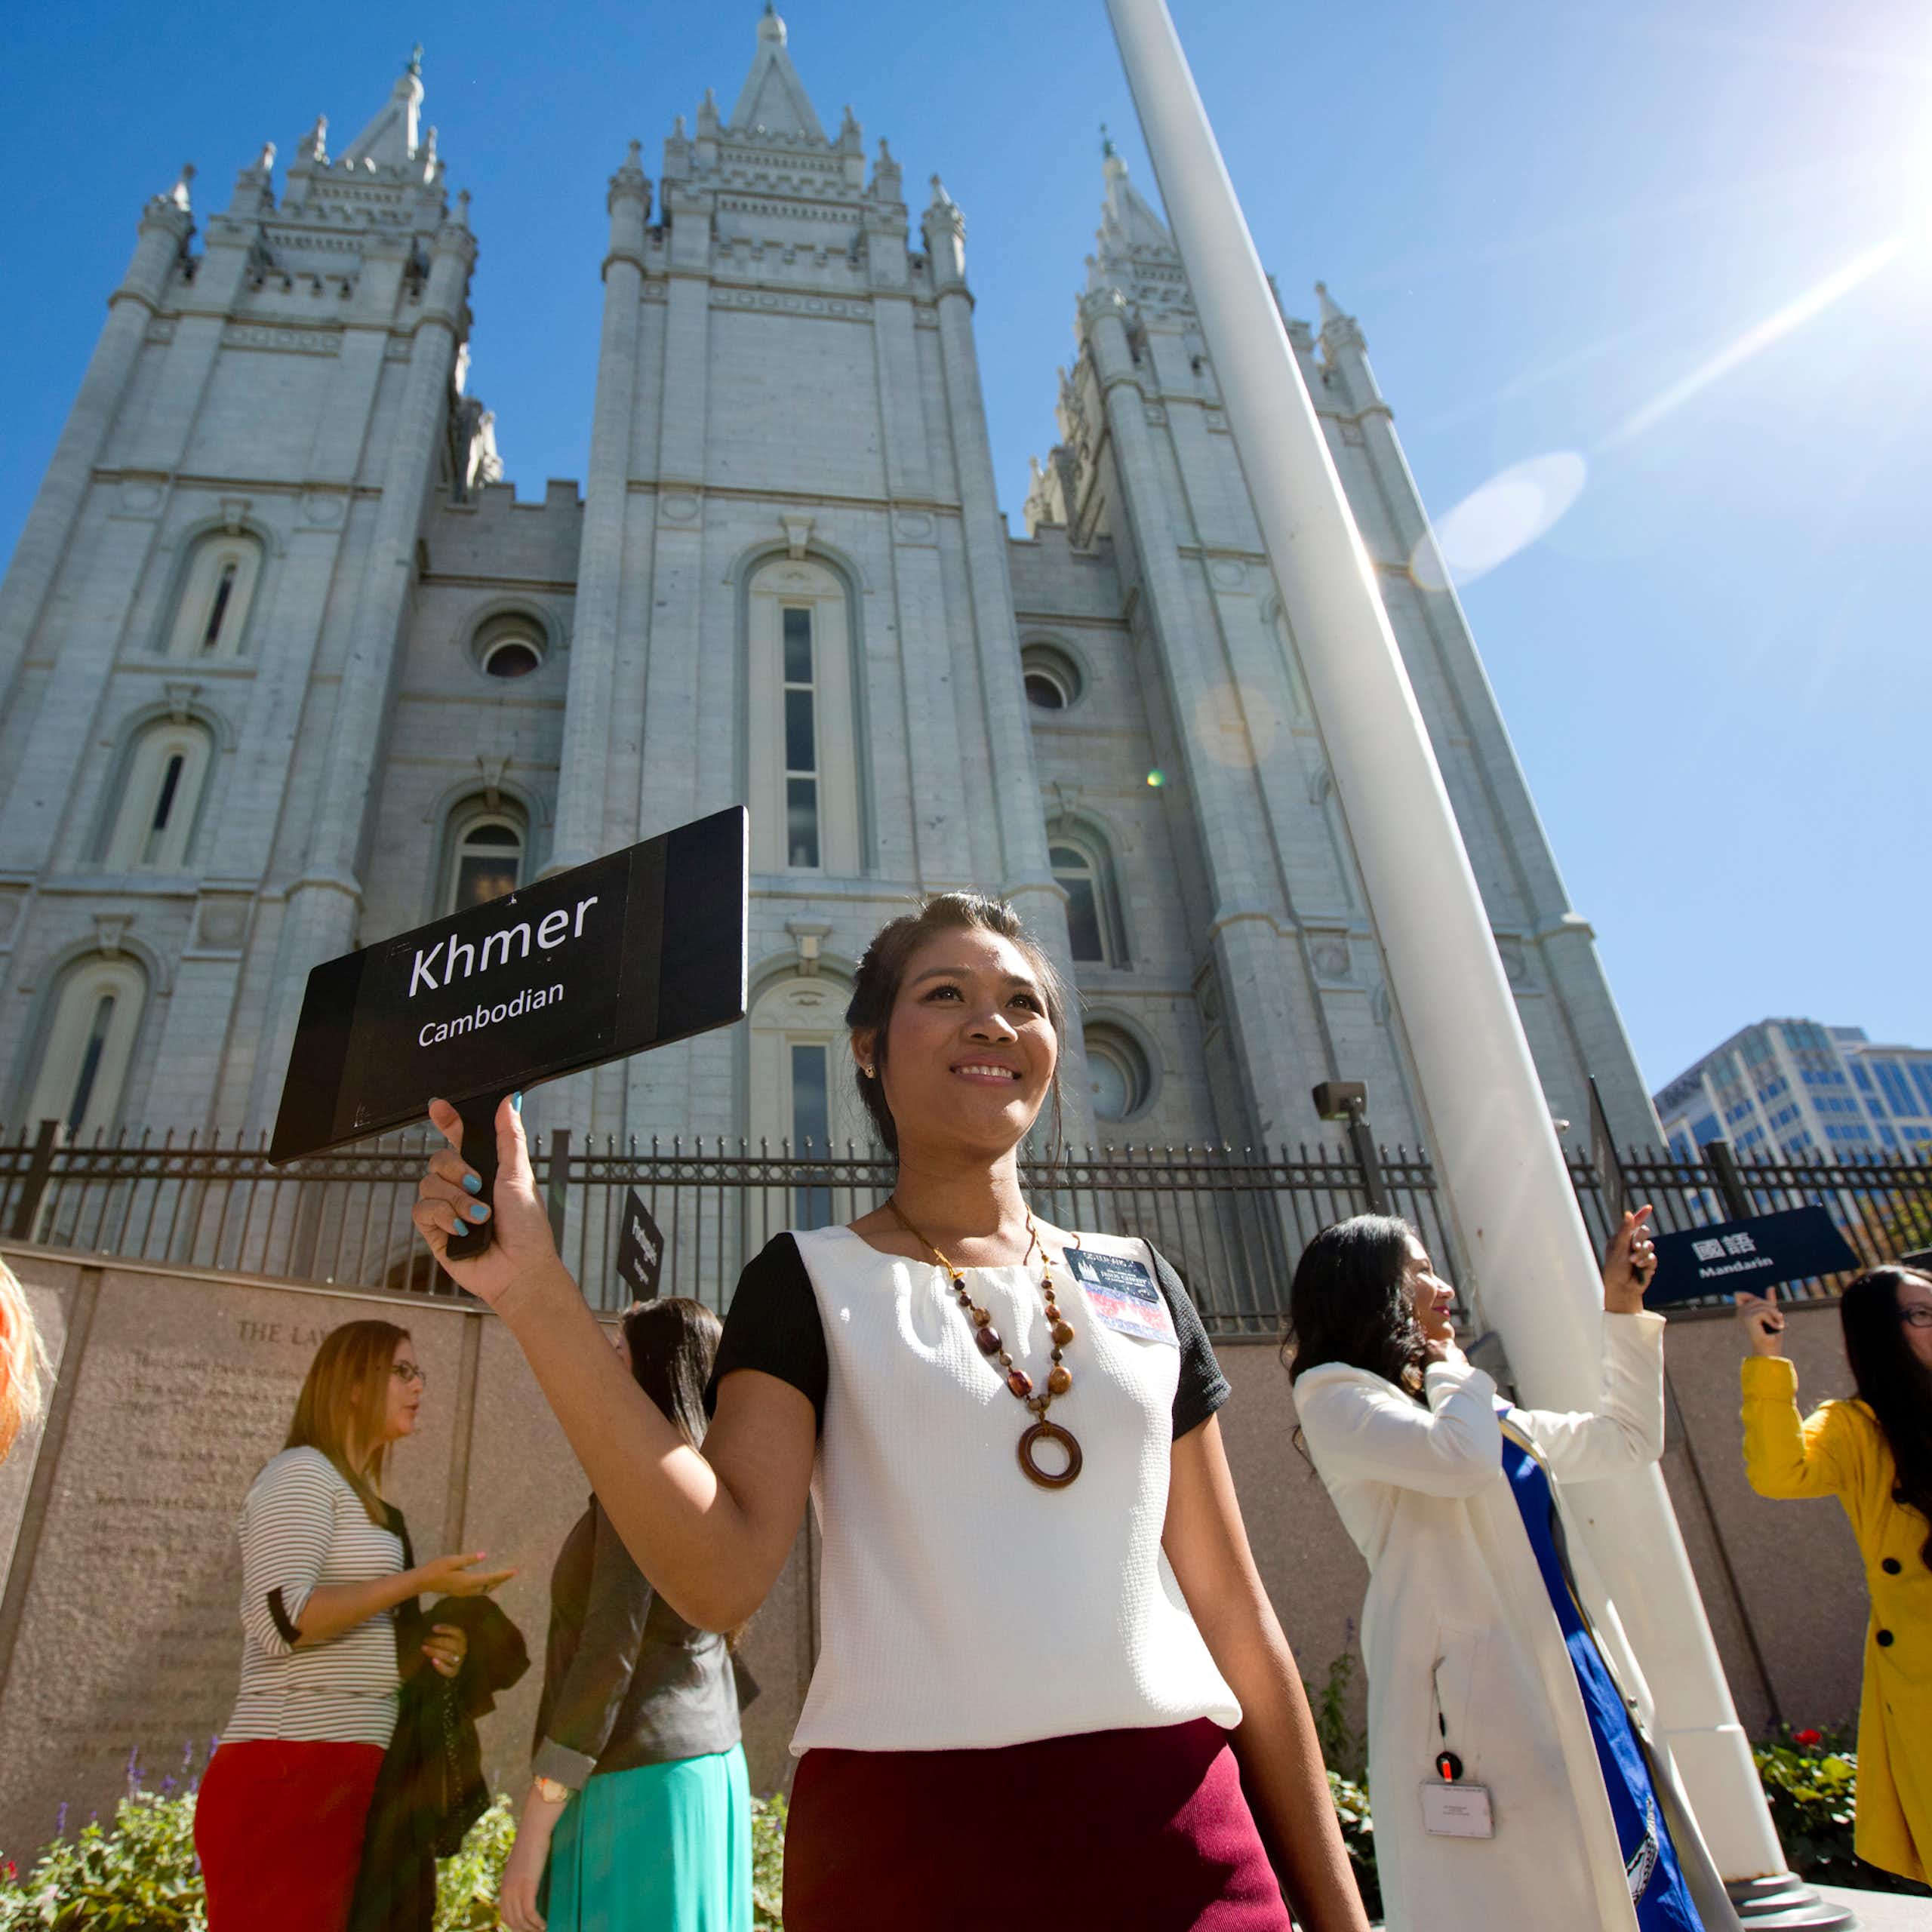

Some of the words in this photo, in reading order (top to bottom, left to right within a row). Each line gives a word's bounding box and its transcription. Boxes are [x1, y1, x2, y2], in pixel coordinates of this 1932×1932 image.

[408, 896, 598, 998] Khmer
[418, 983, 565, 1048] Cambodian
[1690, 1231, 1757, 1262] 國語
[1698, 1256, 1774, 1279] Mandarin
[236, 1320, 283, 1343] THE
